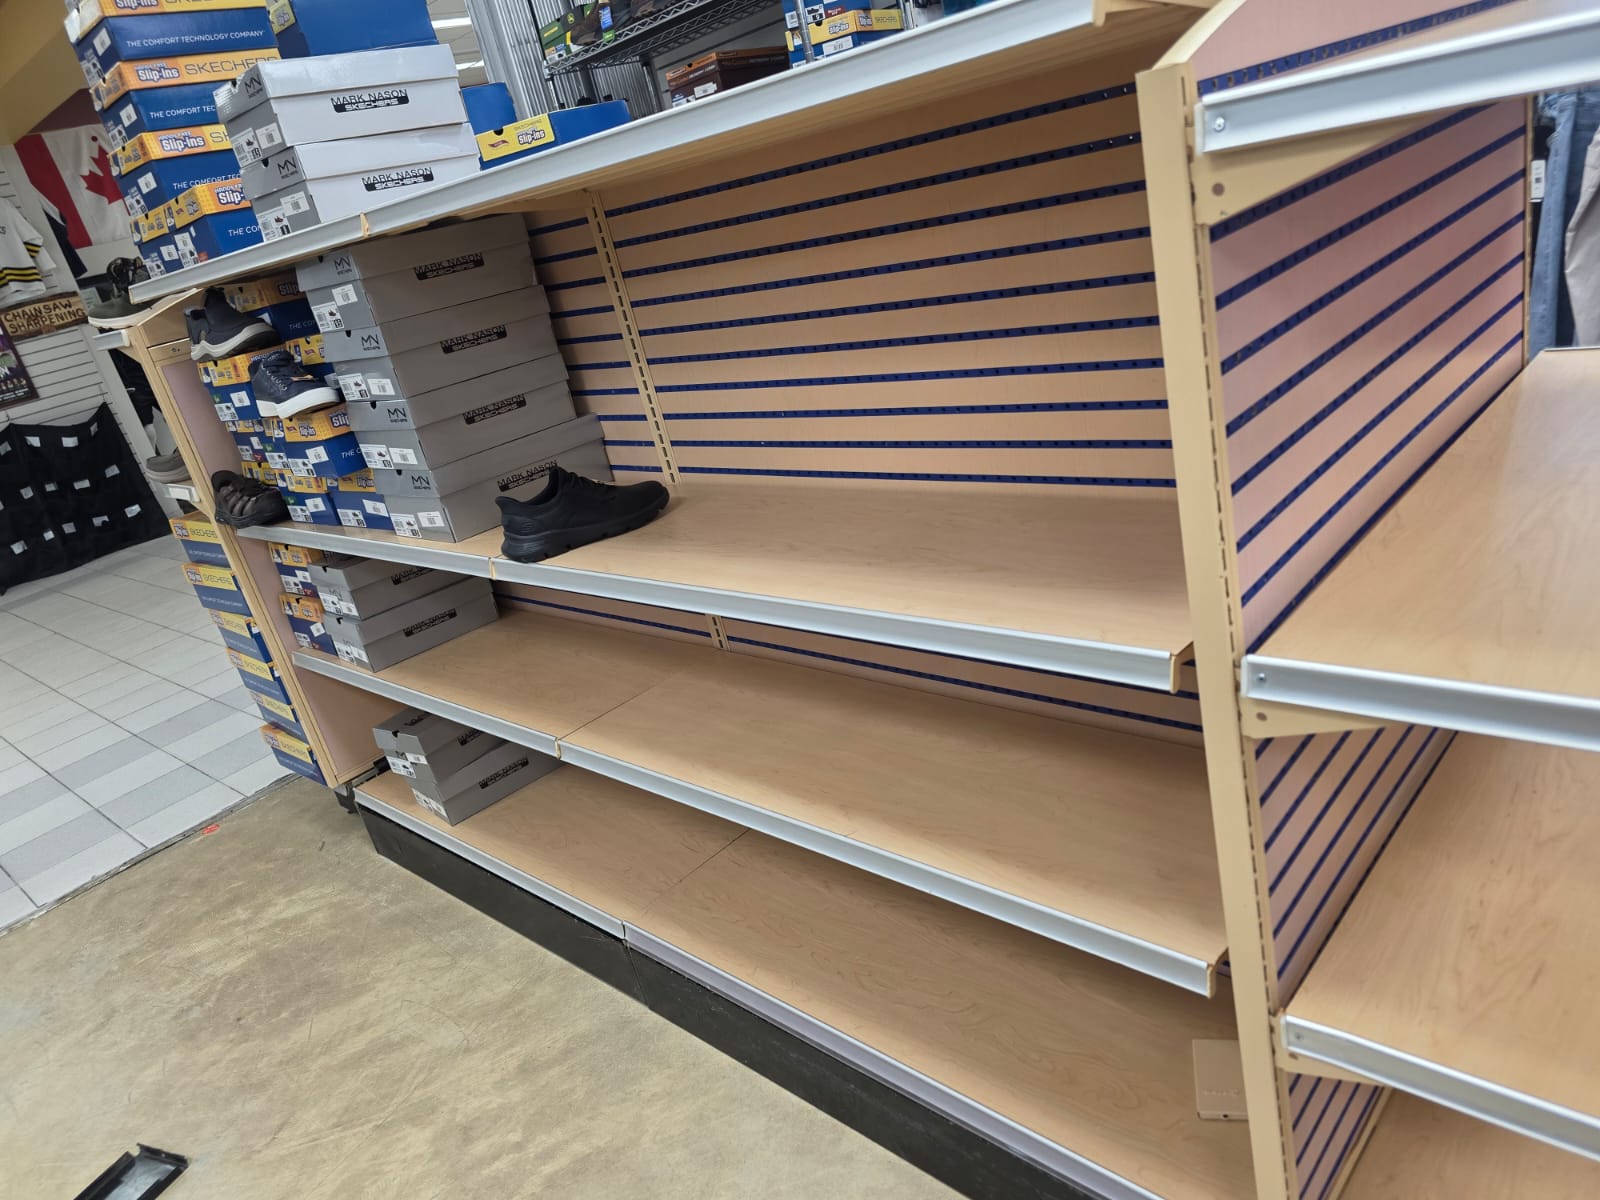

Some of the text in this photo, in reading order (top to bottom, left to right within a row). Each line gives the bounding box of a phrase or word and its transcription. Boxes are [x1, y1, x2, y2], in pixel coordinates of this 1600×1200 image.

[127, 30, 265, 48] THE COMFORT TECHNOLOGY COMPANY
[138, 68, 179, 82] Slip-ins
[184, 57, 277, 75] SKECHE
[330, 88, 408, 106] MARK NASON
[344, 98, 399, 111] SKECHERS
[150, 111, 165, 119] THE
[166, 106, 201, 117] COMFORT
[162, 136, 205, 152] Slip-ins
[518, 130, 546, 145] Slip-ins
[361, 166, 433, 186] MARK NASON
[172, 181, 189, 190] THE
[228, 228, 244, 237] THE
[414, 261, 446, 277] MARK
[447, 252, 483, 267] NASON
[4, 300, 73, 323] CHAINSAW
[9, 307, 87, 334] SHARPENING
[440, 334, 470, 349] MARK
[471, 324, 506, 341] NASON
[387, 407, 407, 419] MN
[462, 404, 491, 419] MARK
[492, 393, 526, 409] NASON
[341, 450, 356, 459] THE
[411, 475, 431, 486] MN
[497, 472, 525, 488] MARK
[526, 460, 558, 478] NASON
